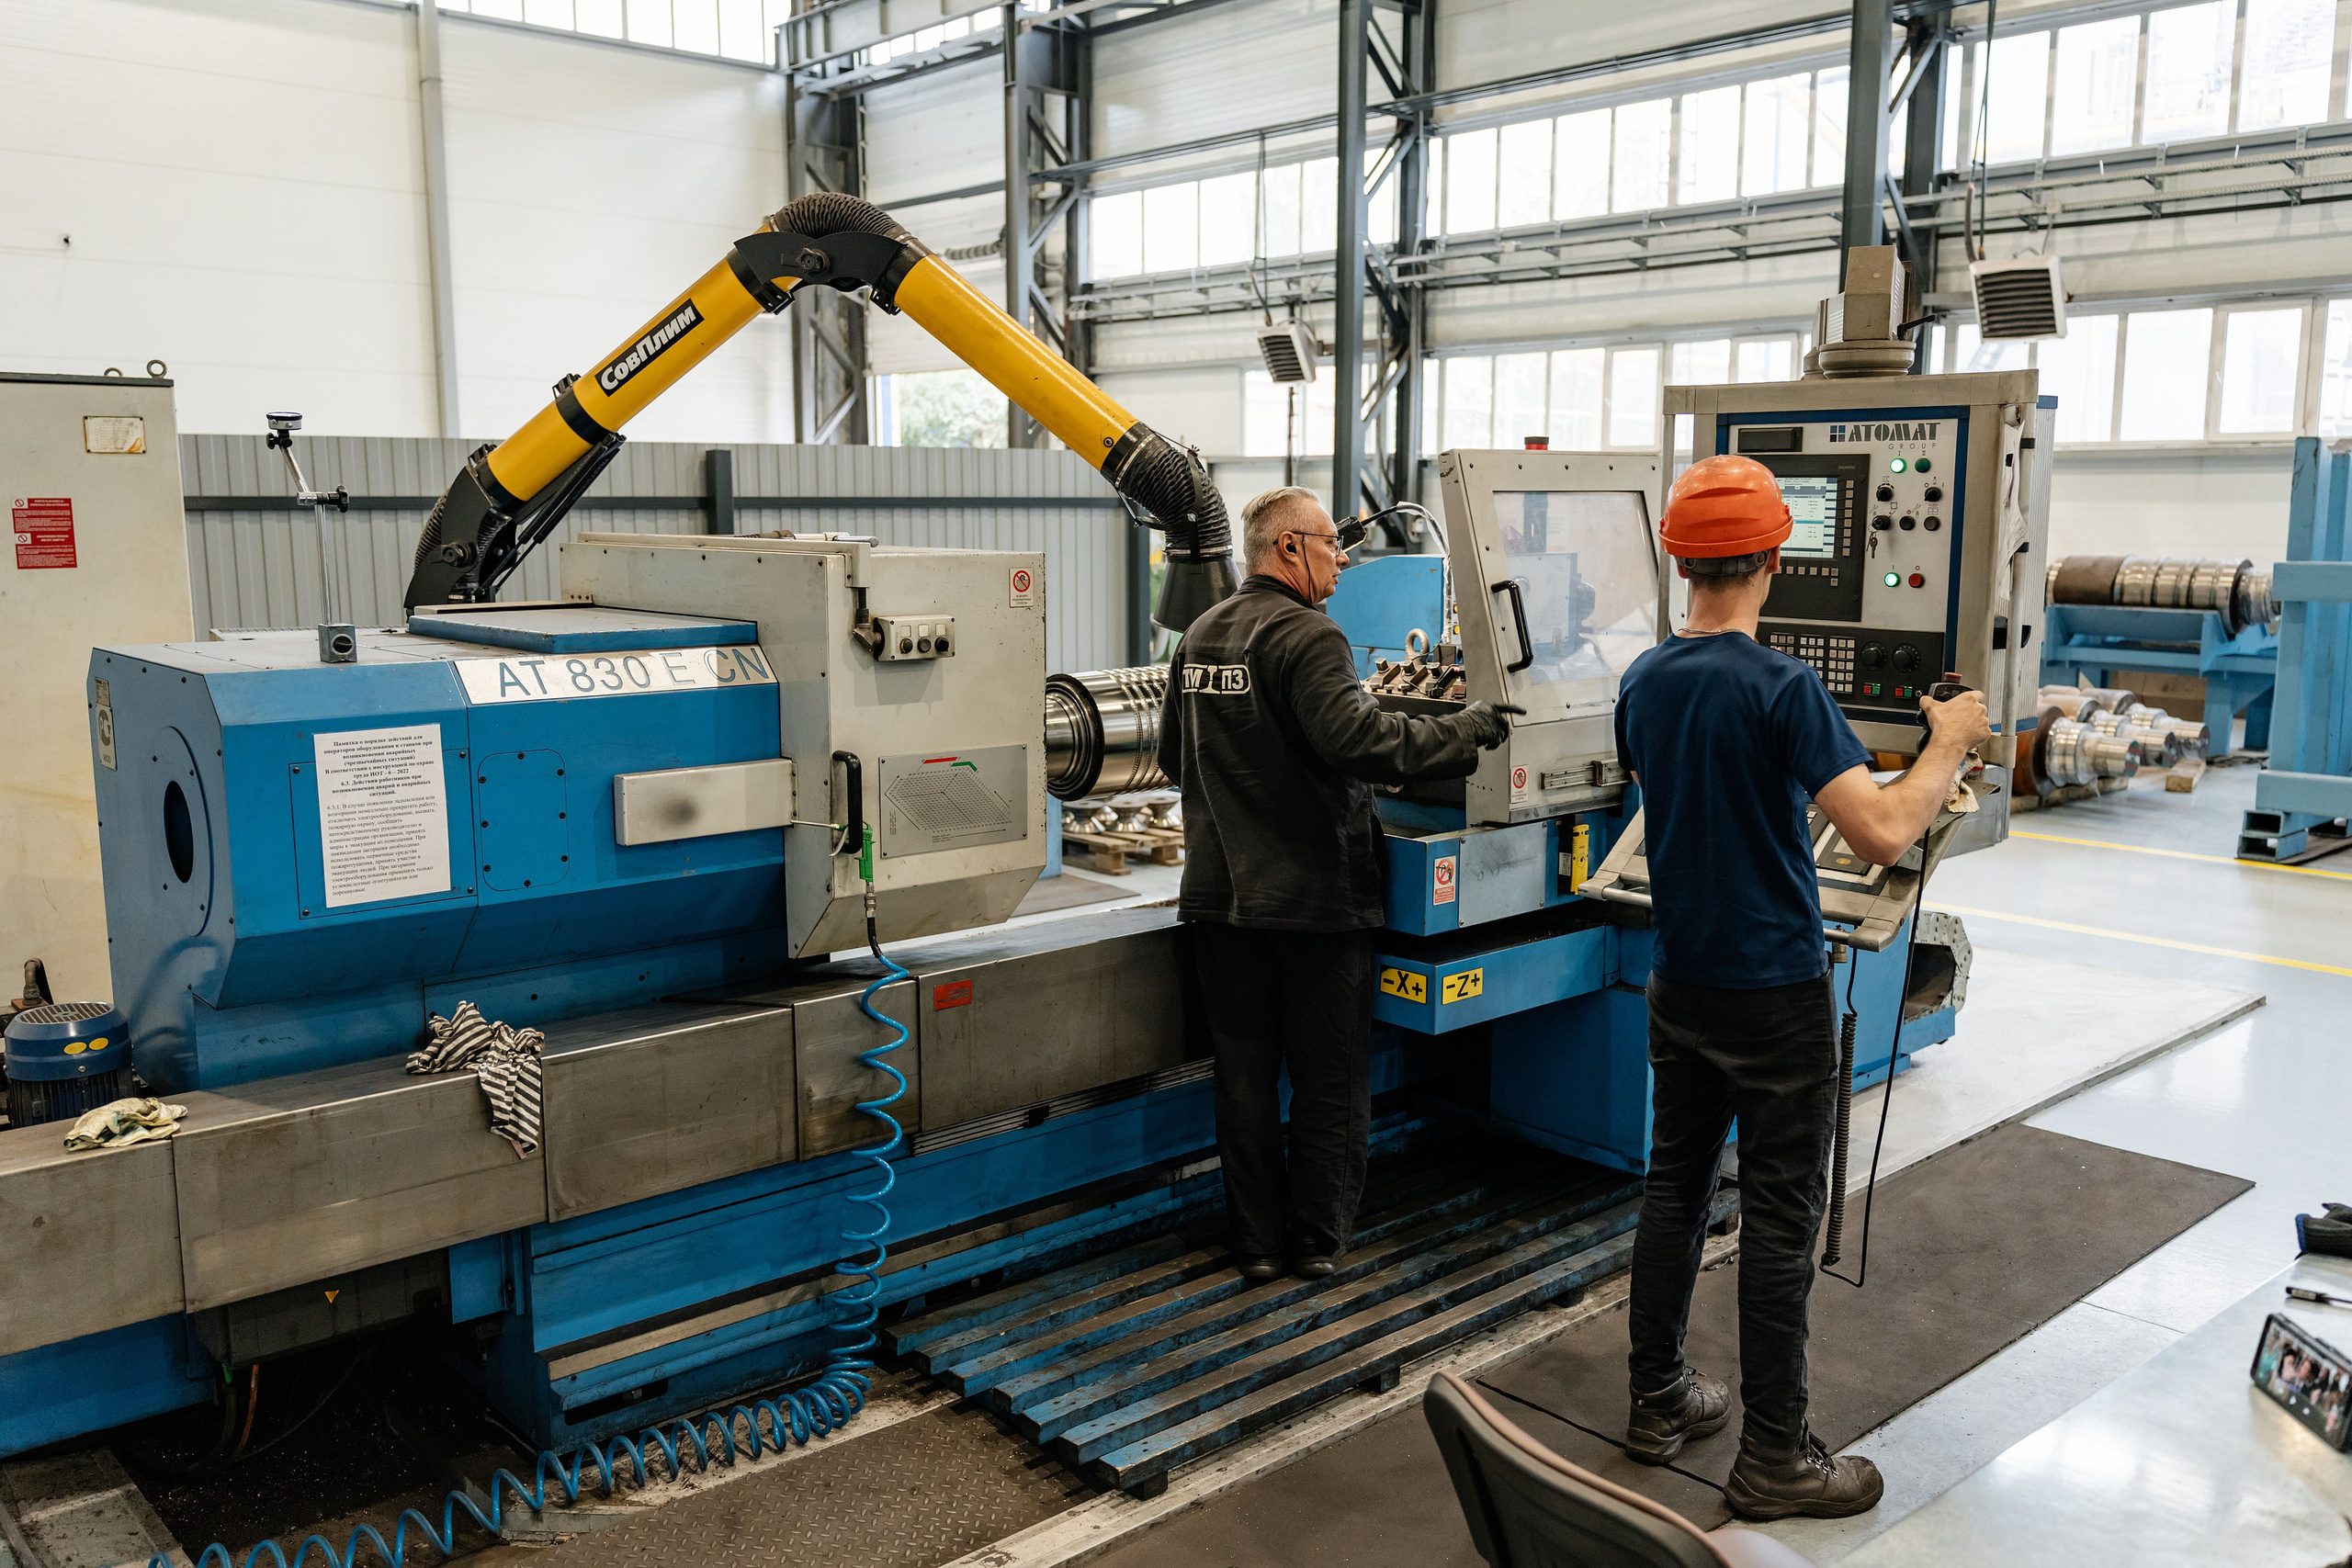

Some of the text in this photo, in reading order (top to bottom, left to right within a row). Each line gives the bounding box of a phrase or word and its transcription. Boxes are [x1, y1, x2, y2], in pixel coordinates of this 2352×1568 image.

[1848, 423, 1941, 442] ATOMAT
[499, 648, 770, 698] AT 830 E CN
